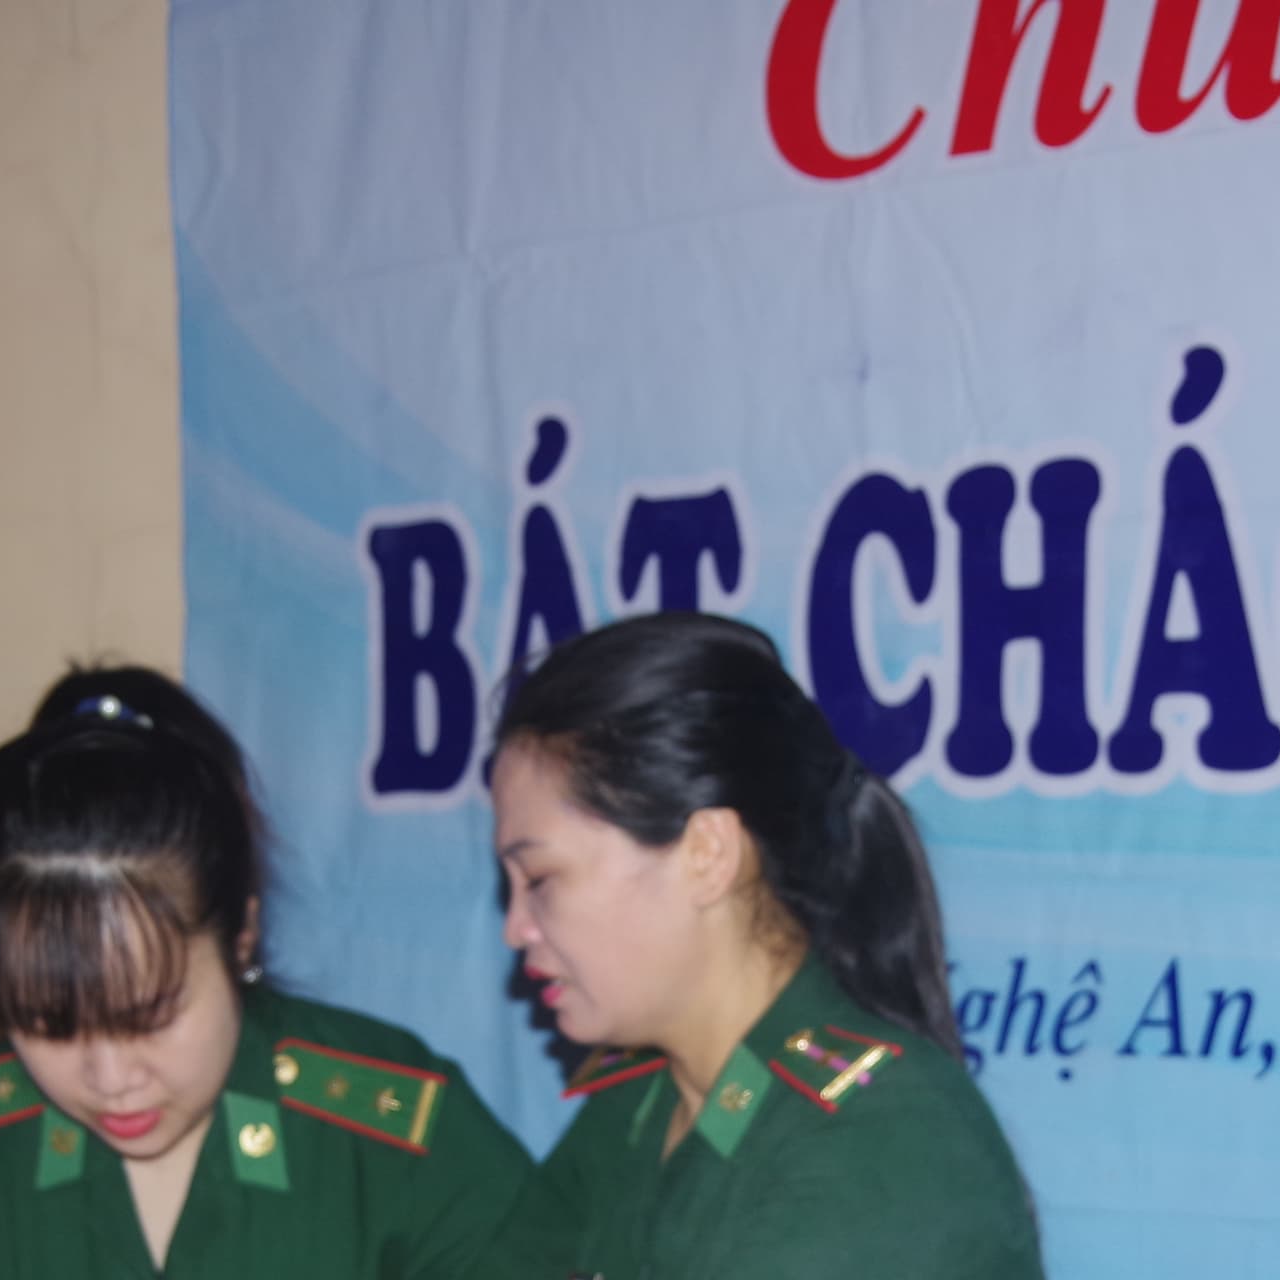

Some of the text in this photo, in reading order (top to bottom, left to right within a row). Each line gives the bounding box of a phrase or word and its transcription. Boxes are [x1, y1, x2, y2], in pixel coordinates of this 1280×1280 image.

[369, 418, 744, 797] BÁT
[946, 956, 1104, 1083] ghệ
[1116, 956, 1278, 1079] An,
